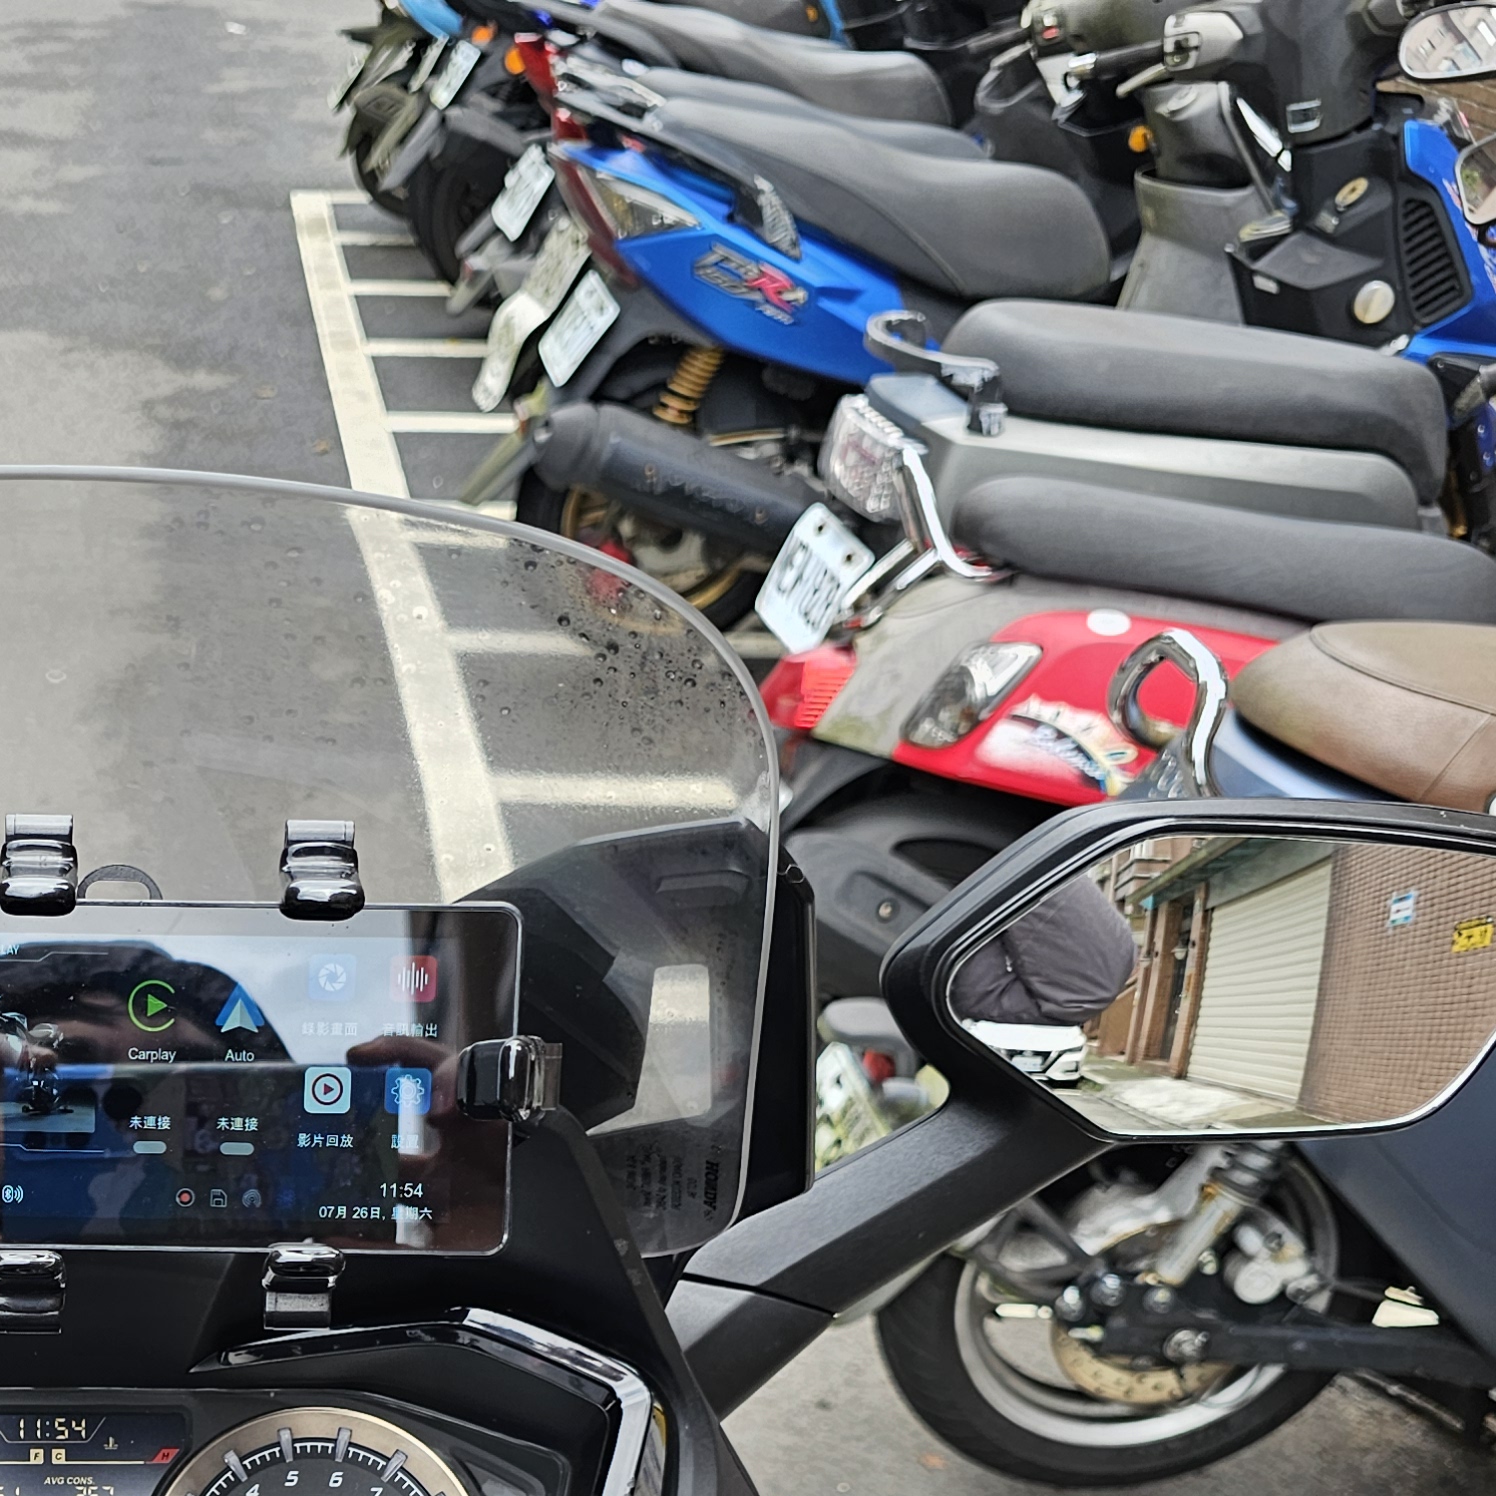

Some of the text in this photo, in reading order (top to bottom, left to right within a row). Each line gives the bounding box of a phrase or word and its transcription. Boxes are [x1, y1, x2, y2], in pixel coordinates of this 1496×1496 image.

[128, 1047, 176, 1063] Carplay
[225, 1048, 255, 1062] Auto
[129, 1115, 171, 1130] 未連接
[216, 1117, 259, 1132] 未連接
[297, 1133, 354, 1148] 影片回放
[379, 1182, 423, 1198] 11:54
[703, 1160, 719, 1210] HONDA
[318, 1206, 347, 1219] 07月
[19, 1417, 86, 1440] 11:54
[33, 1452, 40, 1461] F
[55, 1452, 62, 1461] C
[161, 1452, 169, 1461] H
[44, 1476, 95, 1485] AVG CONS.
[284, 1471, 299, 1487] 5
[328, 1471, 344, 1487] 6
